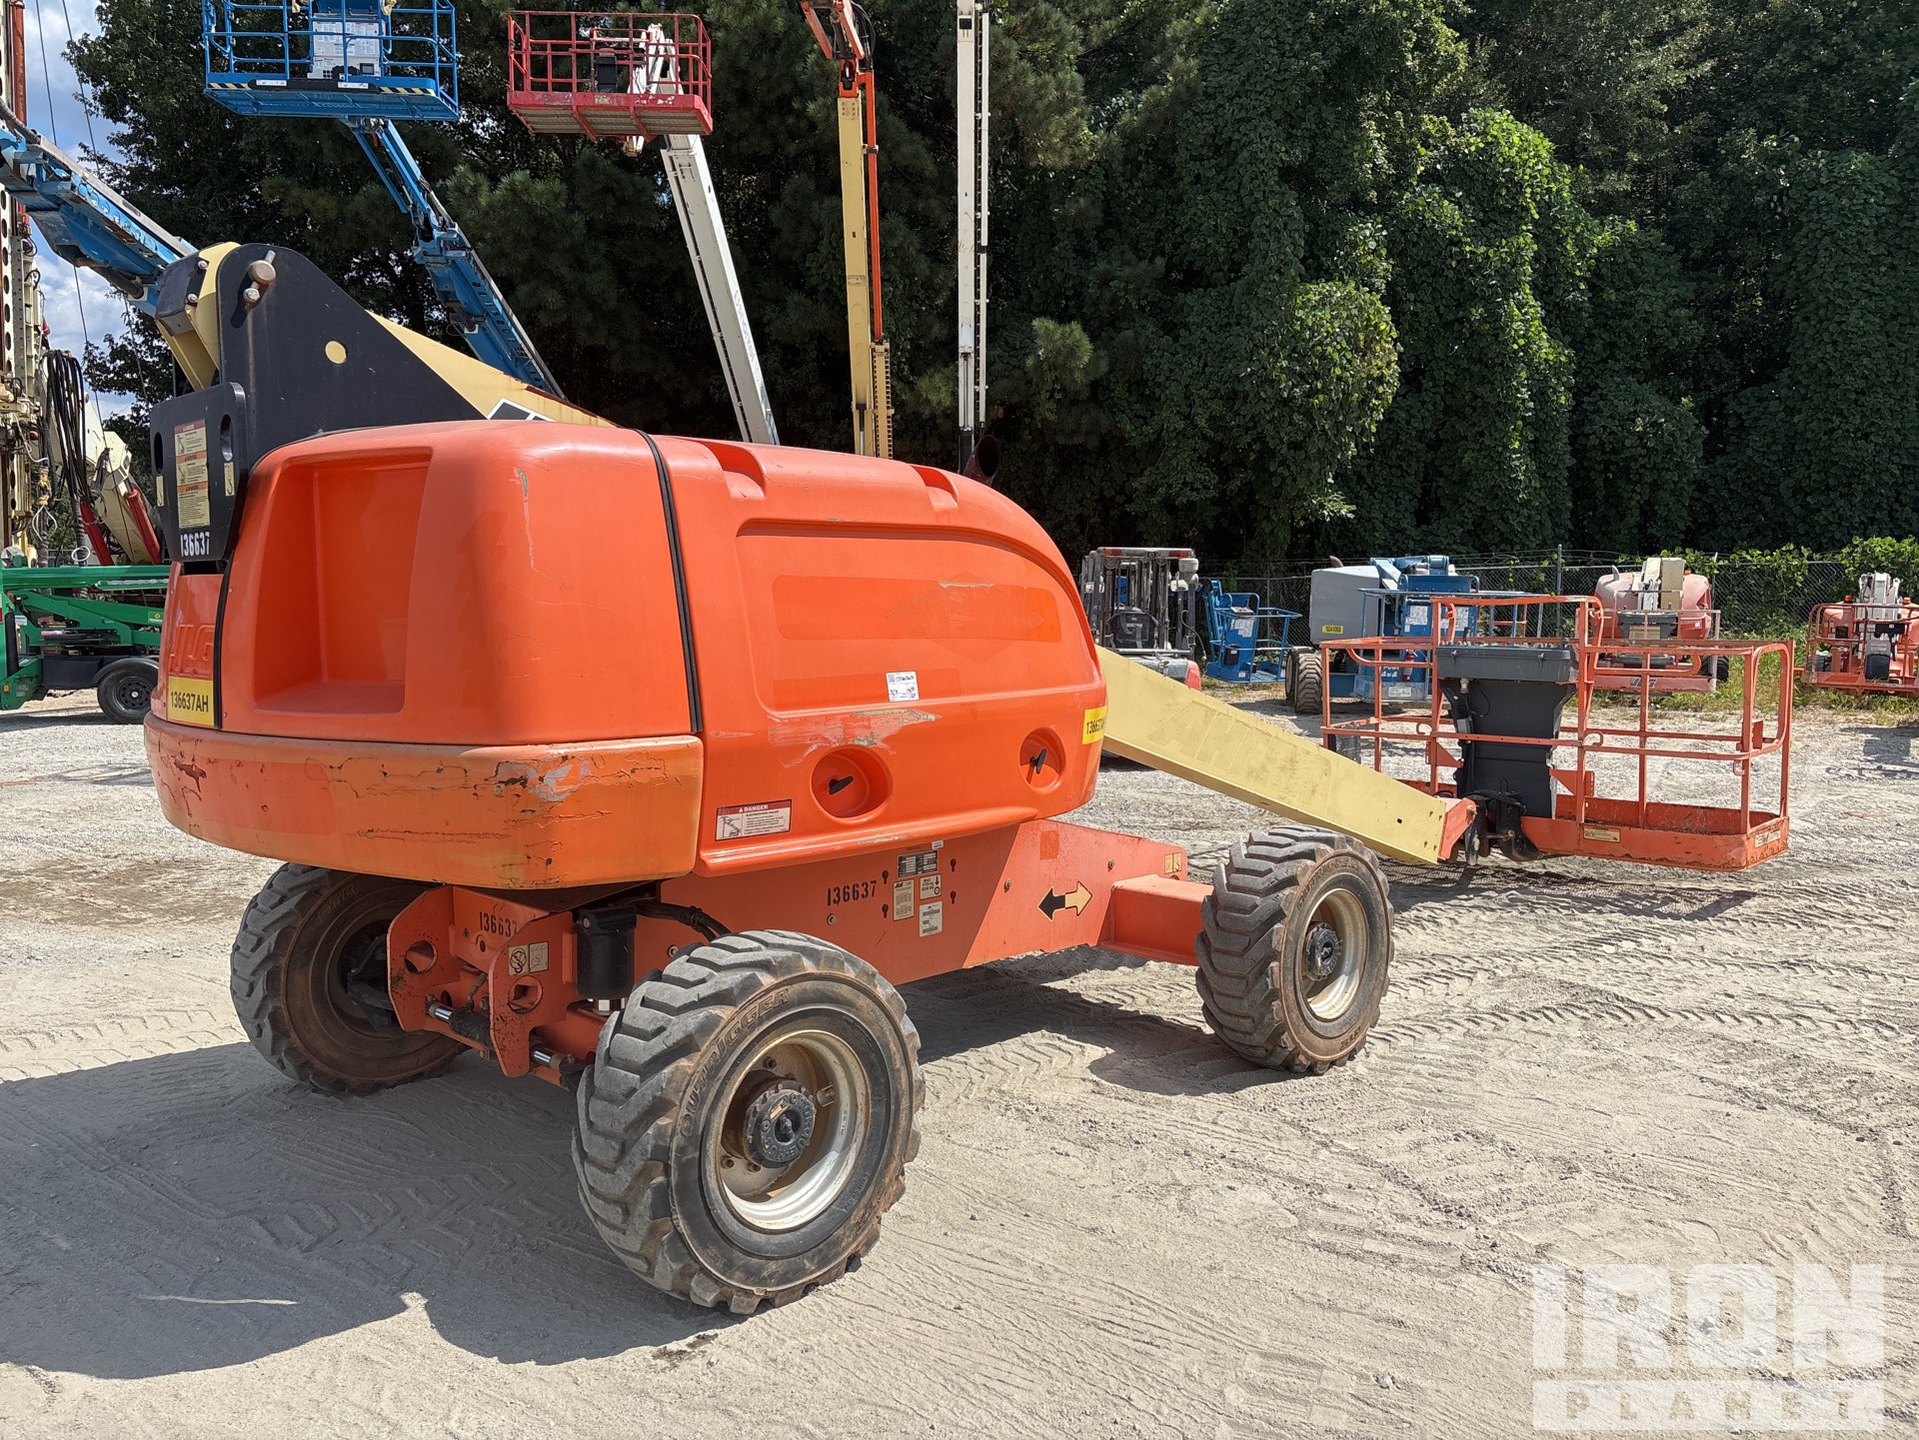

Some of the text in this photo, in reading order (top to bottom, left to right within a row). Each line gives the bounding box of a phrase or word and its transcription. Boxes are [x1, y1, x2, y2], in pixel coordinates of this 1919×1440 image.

[181, 532, 210, 557] 136637
[171, 691, 209, 713] 136637AH
[744, 804, 769, 812] DANGER
[318, 884, 358, 921] OTR
[827, 880, 877, 907] 136637
[480, 911, 518, 938] 136637
[680, 987, 789, 1138] OUTRIGGER
